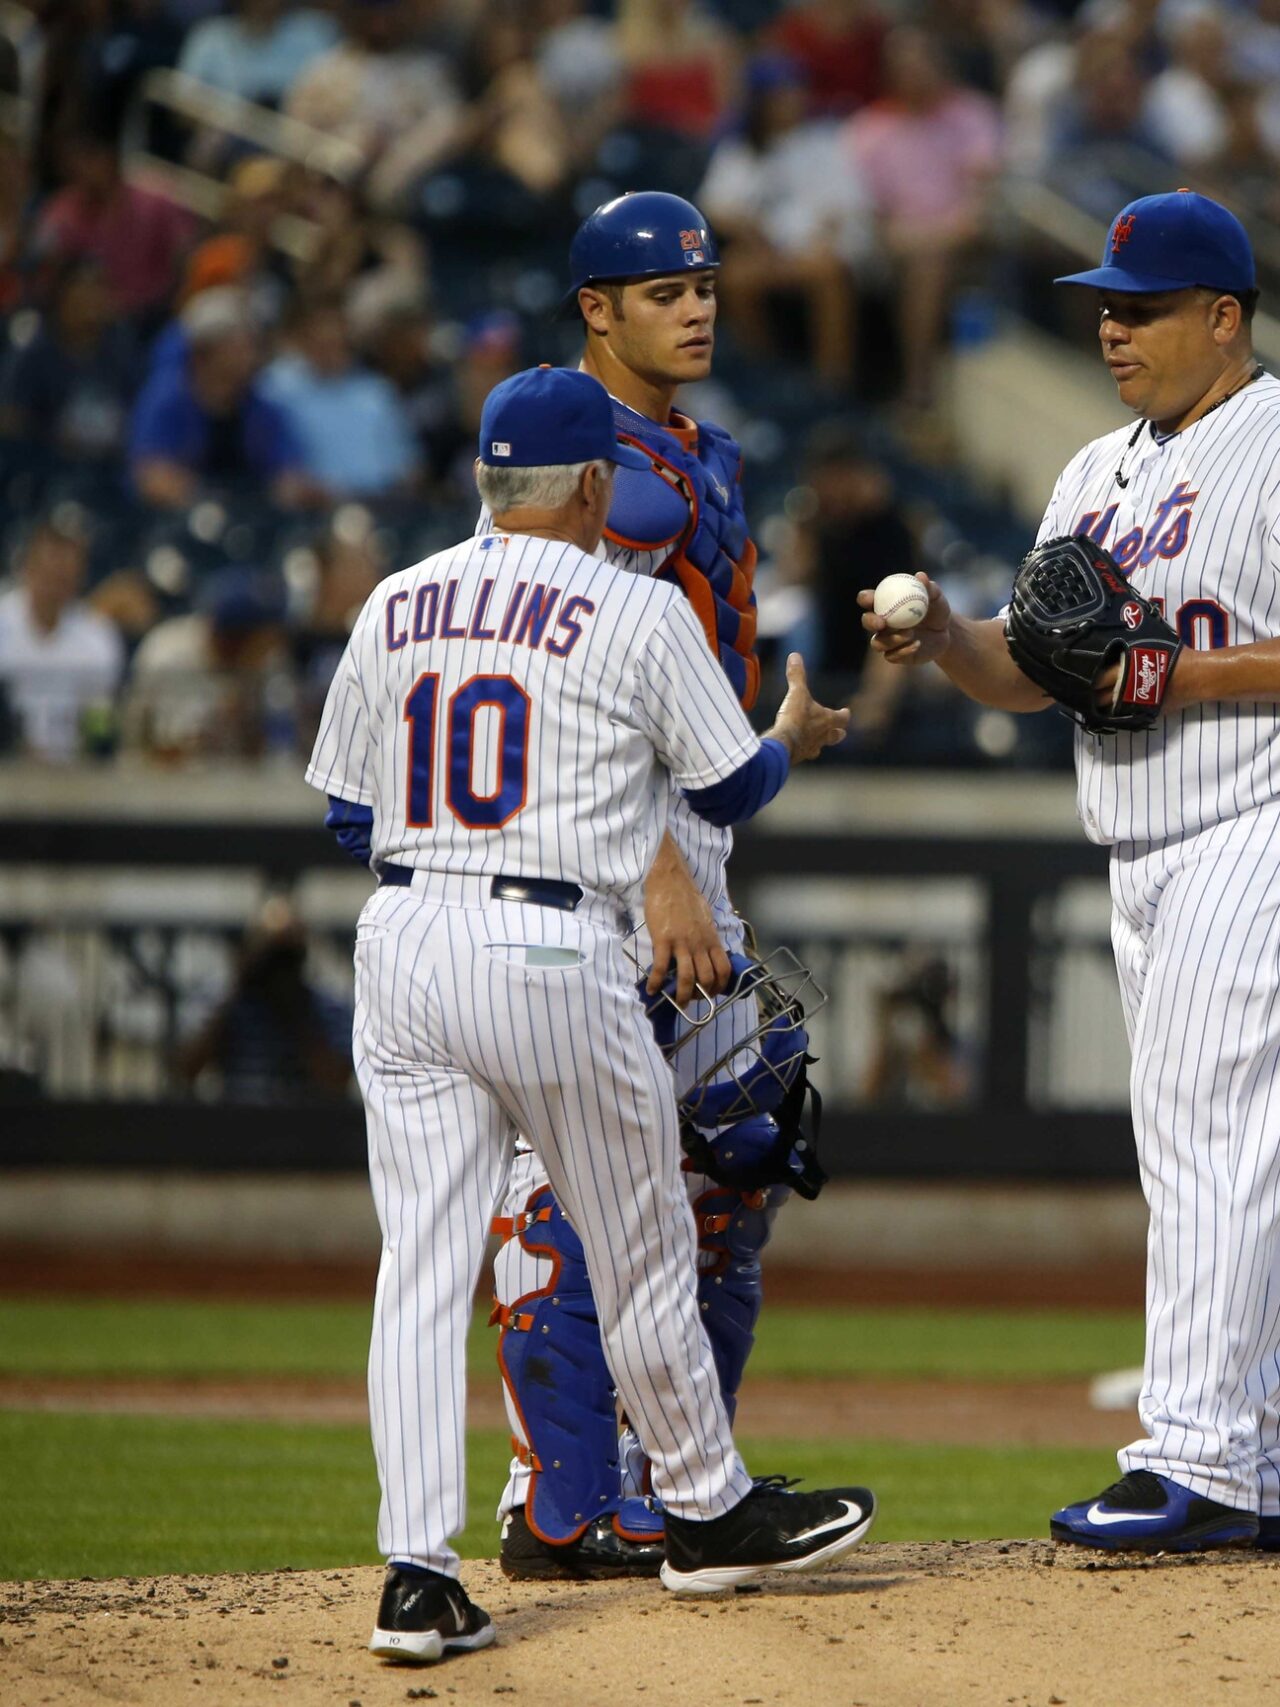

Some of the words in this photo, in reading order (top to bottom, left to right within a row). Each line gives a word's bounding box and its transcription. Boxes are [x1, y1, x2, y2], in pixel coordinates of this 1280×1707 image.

[679, 230, 700, 250] 20
[386, 578, 595, 657] COLLINS
[1137, 654, 1157, 700] Rawlings
[404, 672, 532, 830] 10
